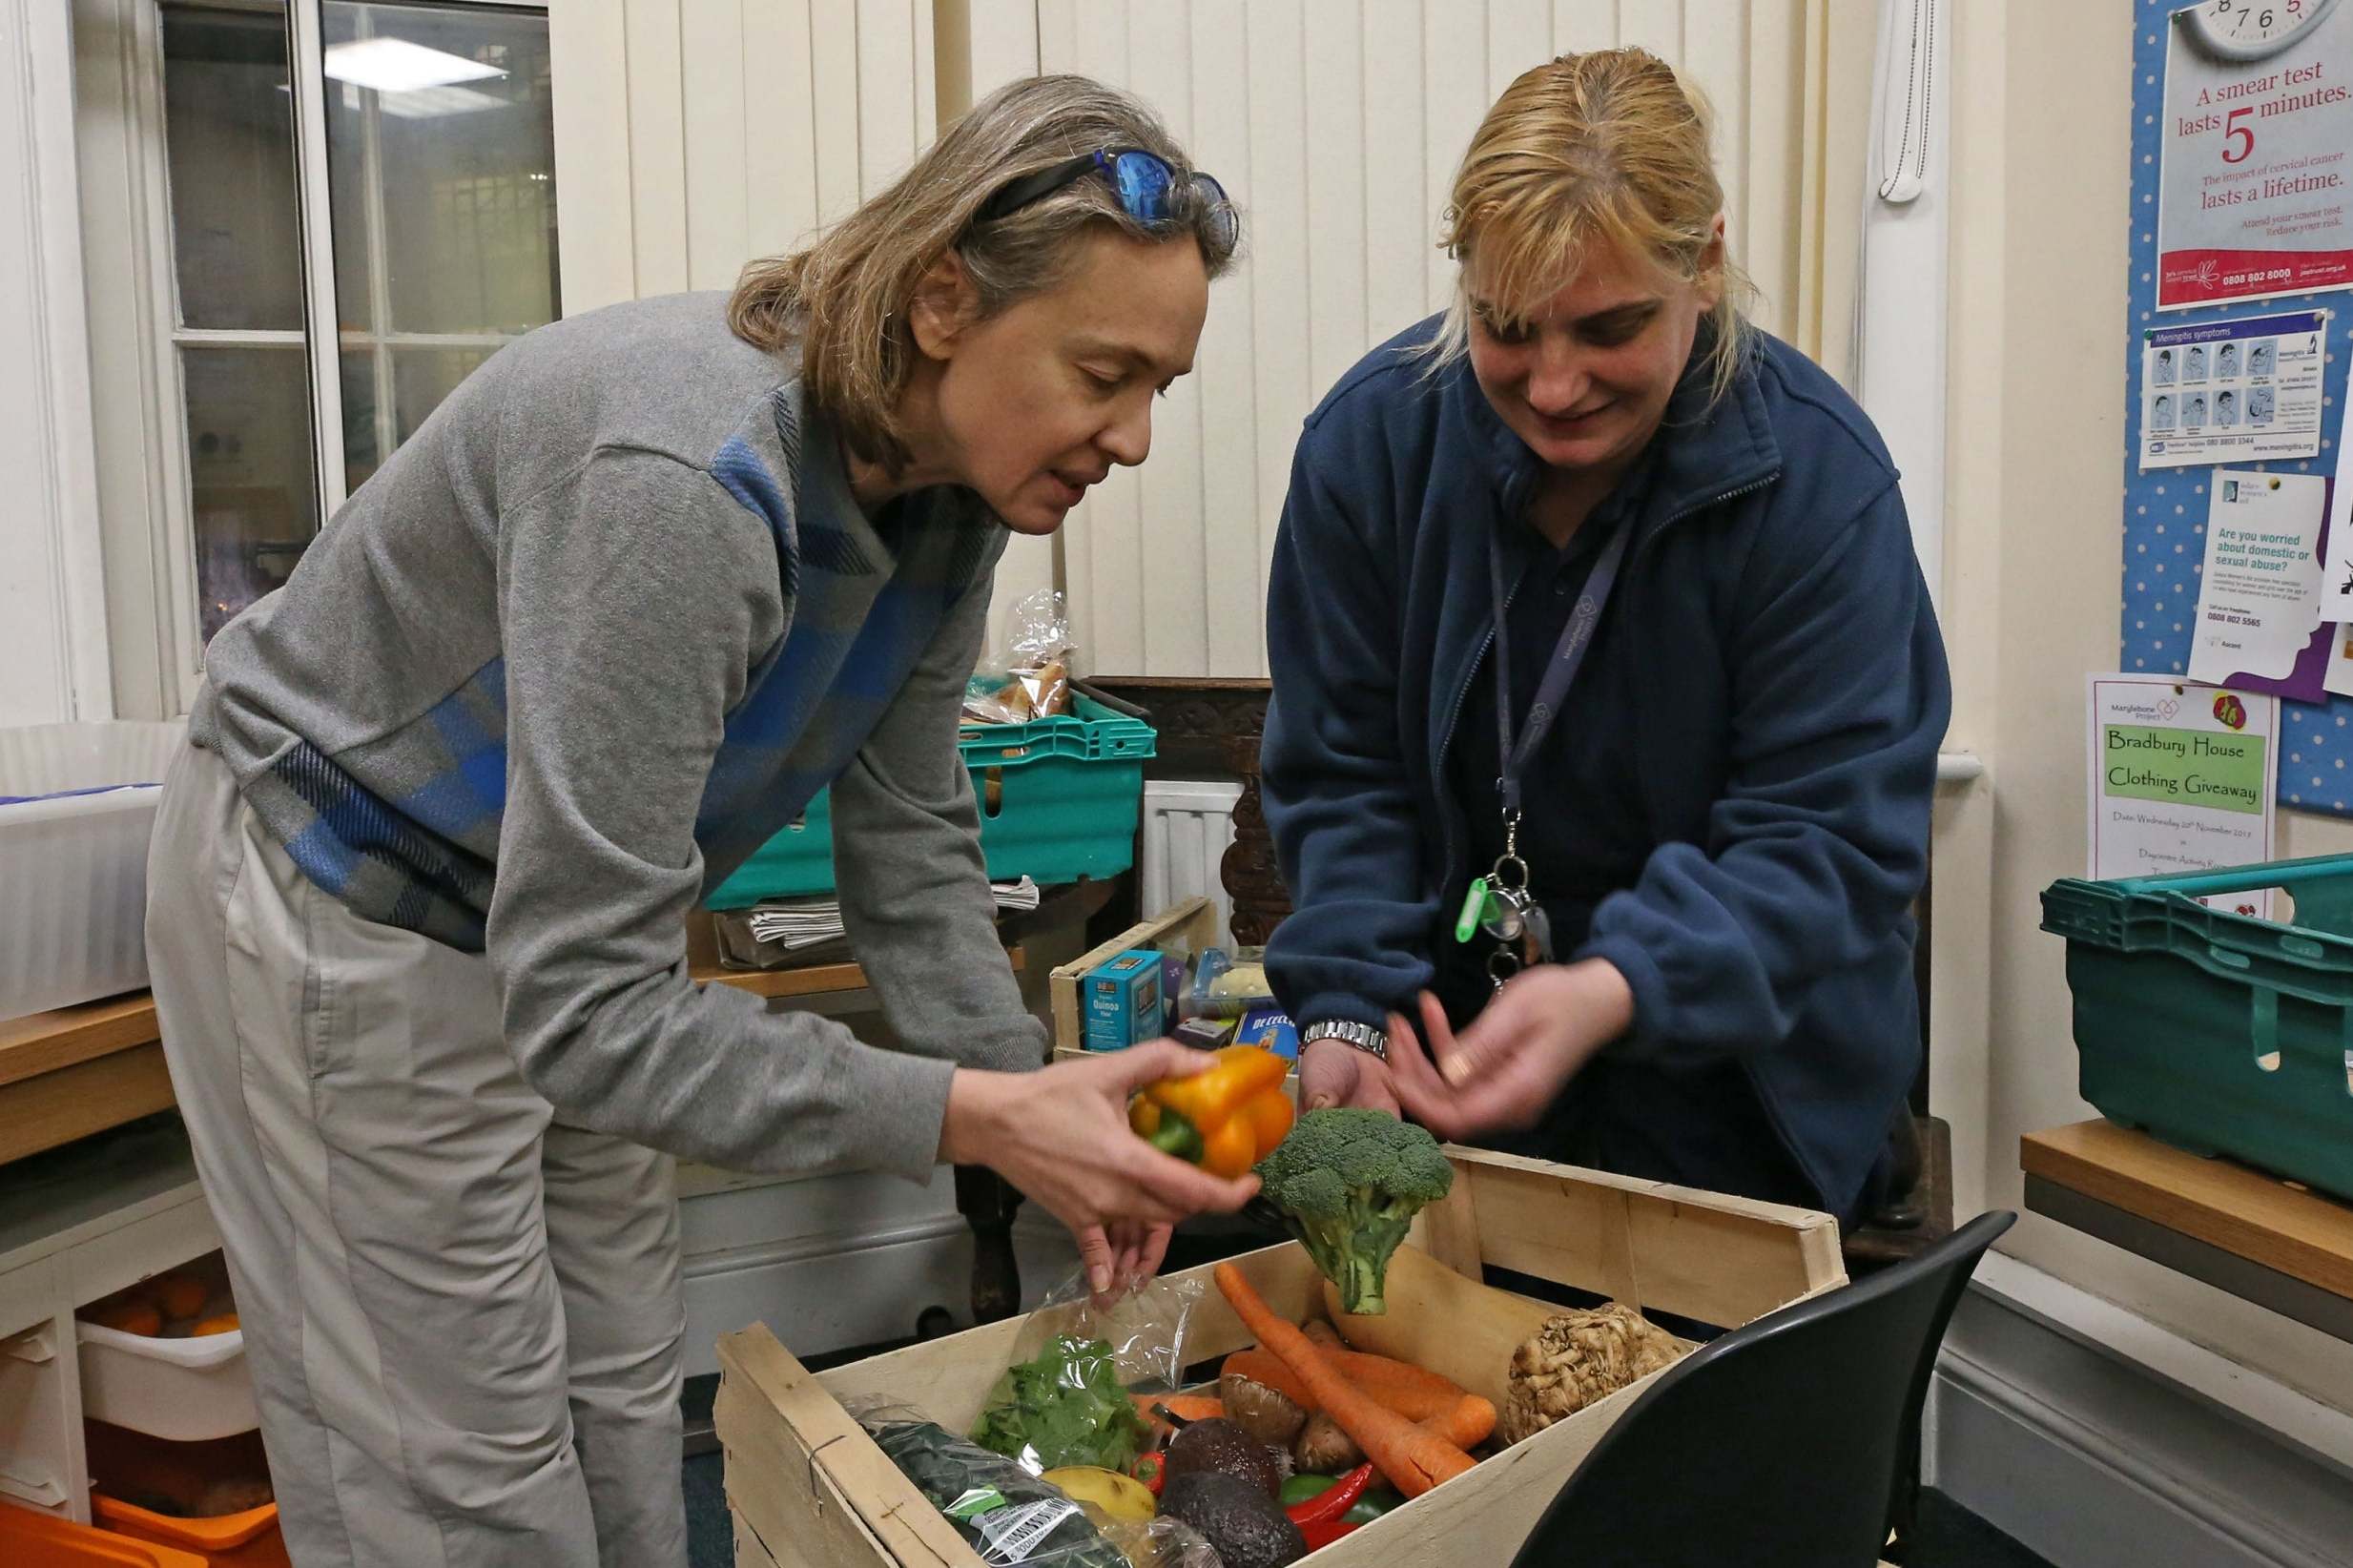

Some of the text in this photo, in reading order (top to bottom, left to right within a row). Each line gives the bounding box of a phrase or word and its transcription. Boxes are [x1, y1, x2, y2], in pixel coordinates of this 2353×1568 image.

[2238, 9, 2250, 27] 7
[2260, 10, 2273, 28] 6
[2197, 61, 2323, 107] A smear test
[2178, 86, 2353, 164] lasts 5 minutes.
[2202, 152, 2345, 188] The impact of cervical cancer
[2201, 173, 2343, 210] lasts a lifetime.
[2223, 274, 2246, 285] 0808
[2247, 271, 2265, 282] 802
[2267, 268, 2291, 279] 8000
[2156, 328, 2231, 343] Meningitis symptoms
[2219, 527, 2301, 546] Are you worried
[2218, 543, 2309, 561] about domestic or
[2216, 556, 2288, 571] sexual abuse?
[2208, 612, 2225, 622] 0808
[2226, 614, 2240, 625] 802
[2112, 704, 2156, 714] Marylebone
[2109, 731, 2244, 757] Bradbury House
[2108, 767, 2257, 805] Clothing Giveaway
[2136, 815, 2180, 829] Wednesday
[2196, 822, 2233, 836] November
